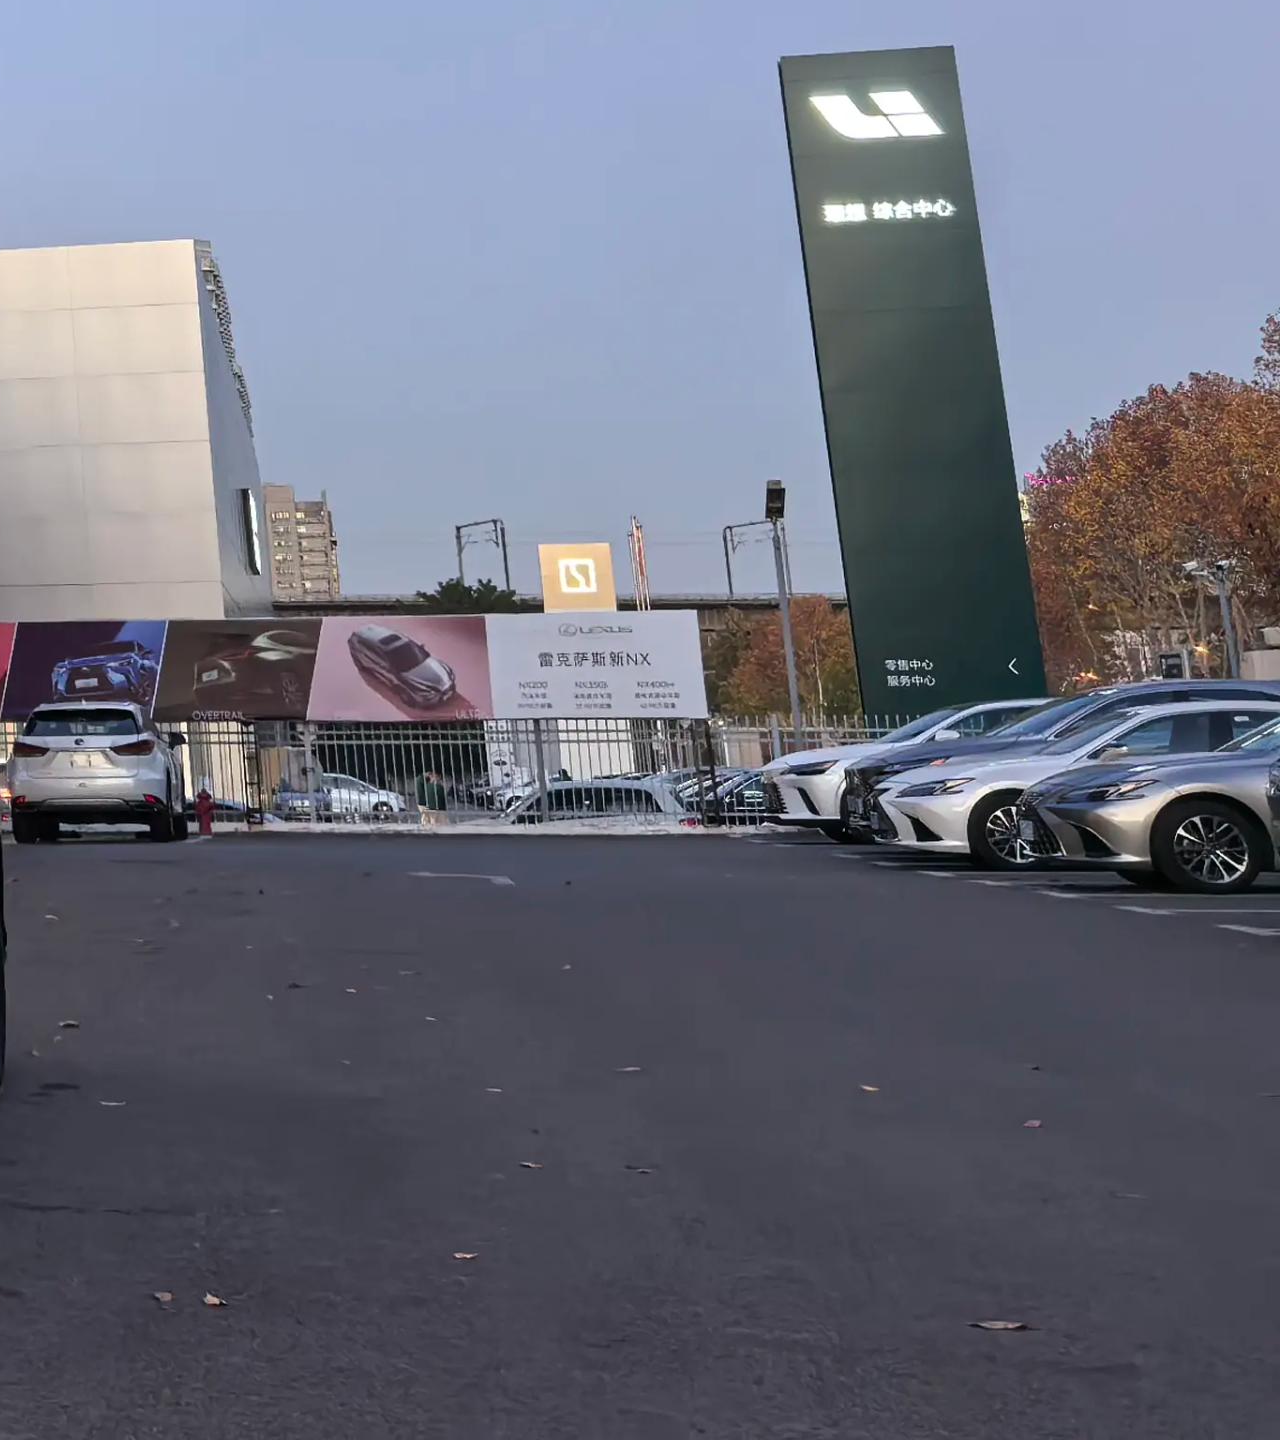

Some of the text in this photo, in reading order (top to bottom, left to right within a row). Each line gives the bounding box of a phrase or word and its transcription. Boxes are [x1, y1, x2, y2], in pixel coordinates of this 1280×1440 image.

[579, 625, 633, 634] LEXUS
[538, 651, 652, 667] 雷克萨斯新NX
[885, 659, 934, 671] 零售中心
[887, 675, 936, 687] 服务中心
